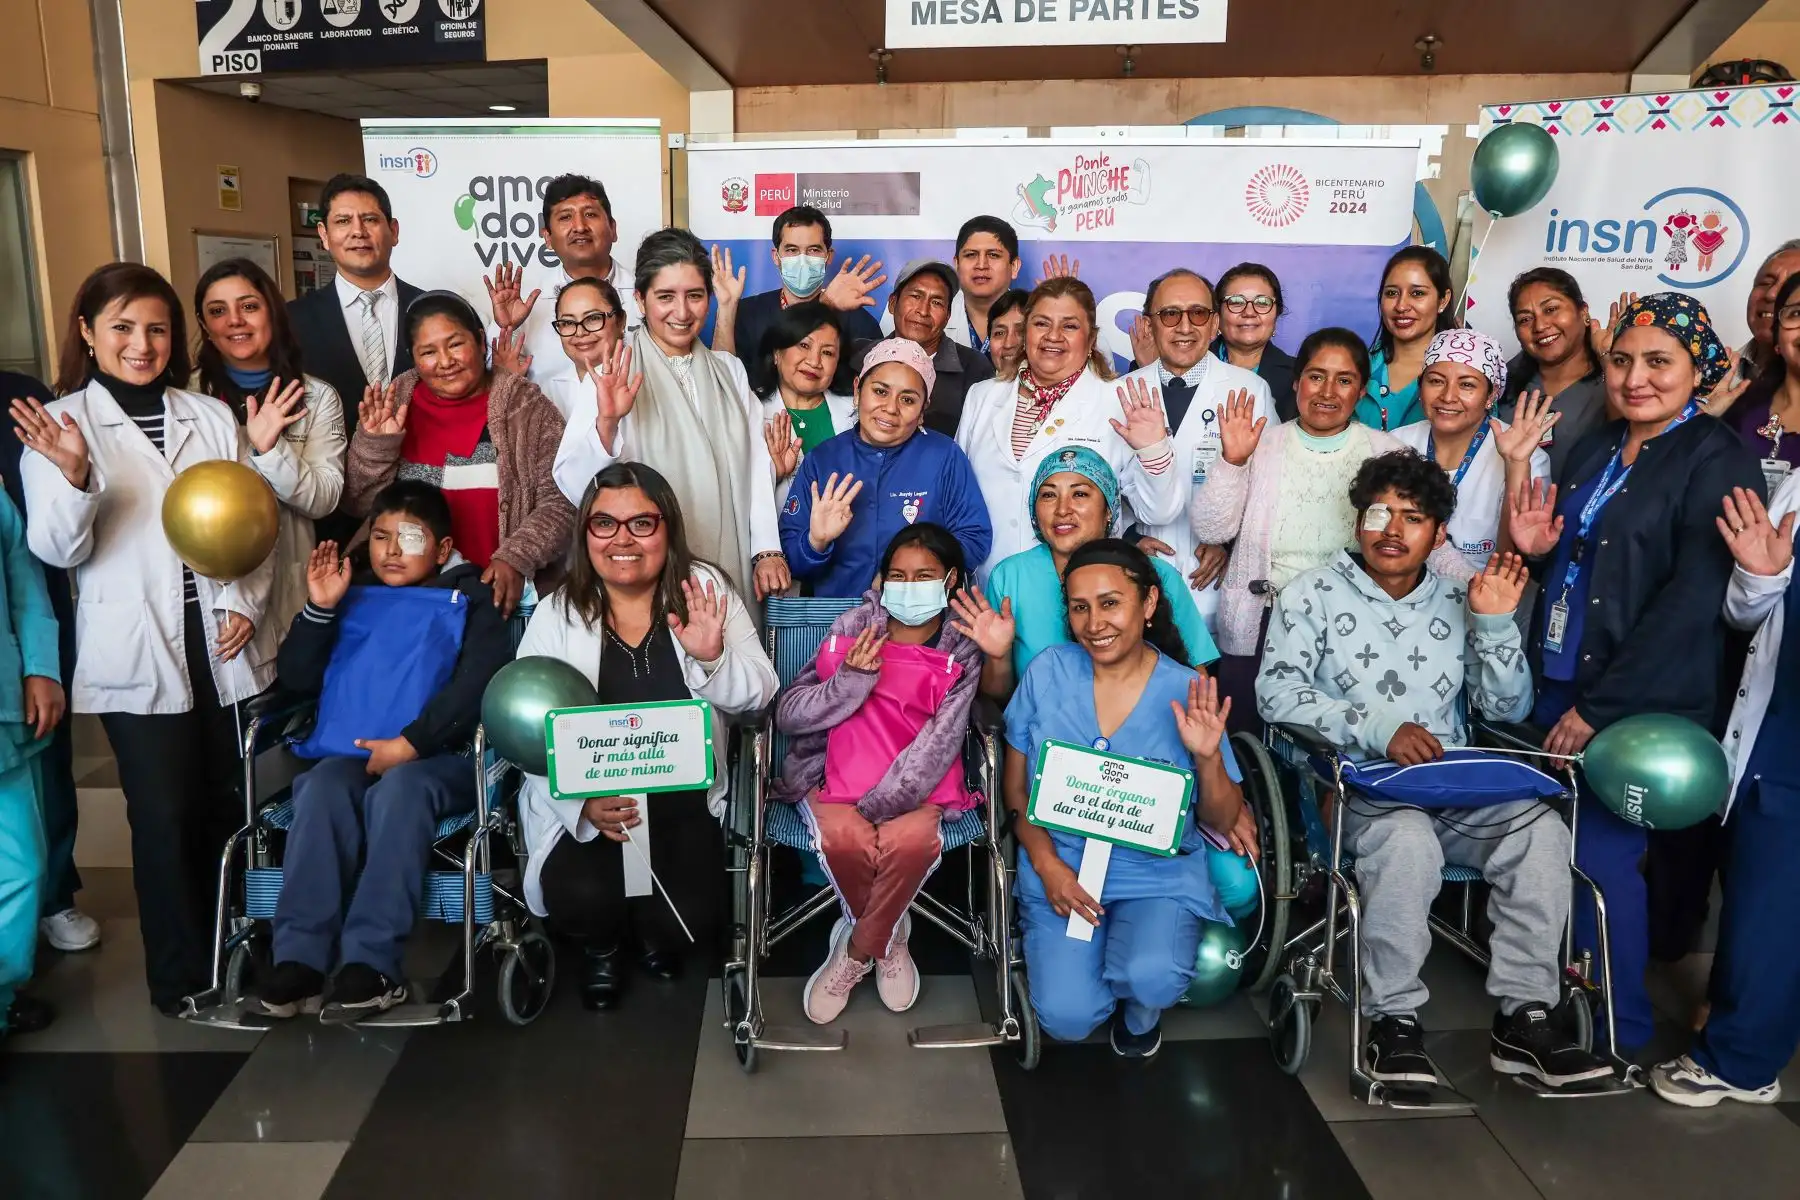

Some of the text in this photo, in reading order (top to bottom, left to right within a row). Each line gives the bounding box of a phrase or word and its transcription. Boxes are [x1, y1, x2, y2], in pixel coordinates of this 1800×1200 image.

[911, 0, 1200, 26] MESA DE PARTES
[382, 25, 420, 36] GENÉTICA
[440, 21, 478, 30] OFICINA DE
[247, 31, 314, 43] BANCO DE SANGRE
[320, 28, 372, 39] LABORATORIO
[444, 30, 476, 39] SEGUROS
[262, 42, 299, 52] /DONANTE
[212, 52, 259, 73] PISO
[379, 153, 414, 168] insn
[1075, 151, 1110, 174] Ponle
[1057, 166, 1130, 205] PUNCHE
[1315, 179, 1385, 188] BICENTENARIO
[760, 186, 791, 201] PERÚ
[803, 188, 850, 198] Ministerio
[1333, 188, 1365, 199] PERÚ
[817, 199, 842, 209] Salud
[1059, 191, 1129, 216] y ganamos todos
[1329, 201, 1368, 214] 2024
[1075, 205, 1115, 232] PERÚ
[1545, 208, 1658, 254] insn
[473, 241, 561, 268] vive
[1634, 264, 1653, 272] Borja
[1462, 540, 1482, 550] insn
[609, 718, 629, 726] insn
[577, 730, 680, 750] Donar significa
[592, 745, 666, 764] ir más allá
[585, 763, 676, 780] de uno mismo
[1103, 760, 1125, 771] ama
[1101, 774, 1122, 785] vive
[1104, 767, 1129, 780] dona
[1065, 774, 1157, 807] Donar órganos
[1073, 793, 1143, 818] es el don de
[1626, 784, 1649, 822] insn
[1053, 801, 1155, 835] dar vida y salud
